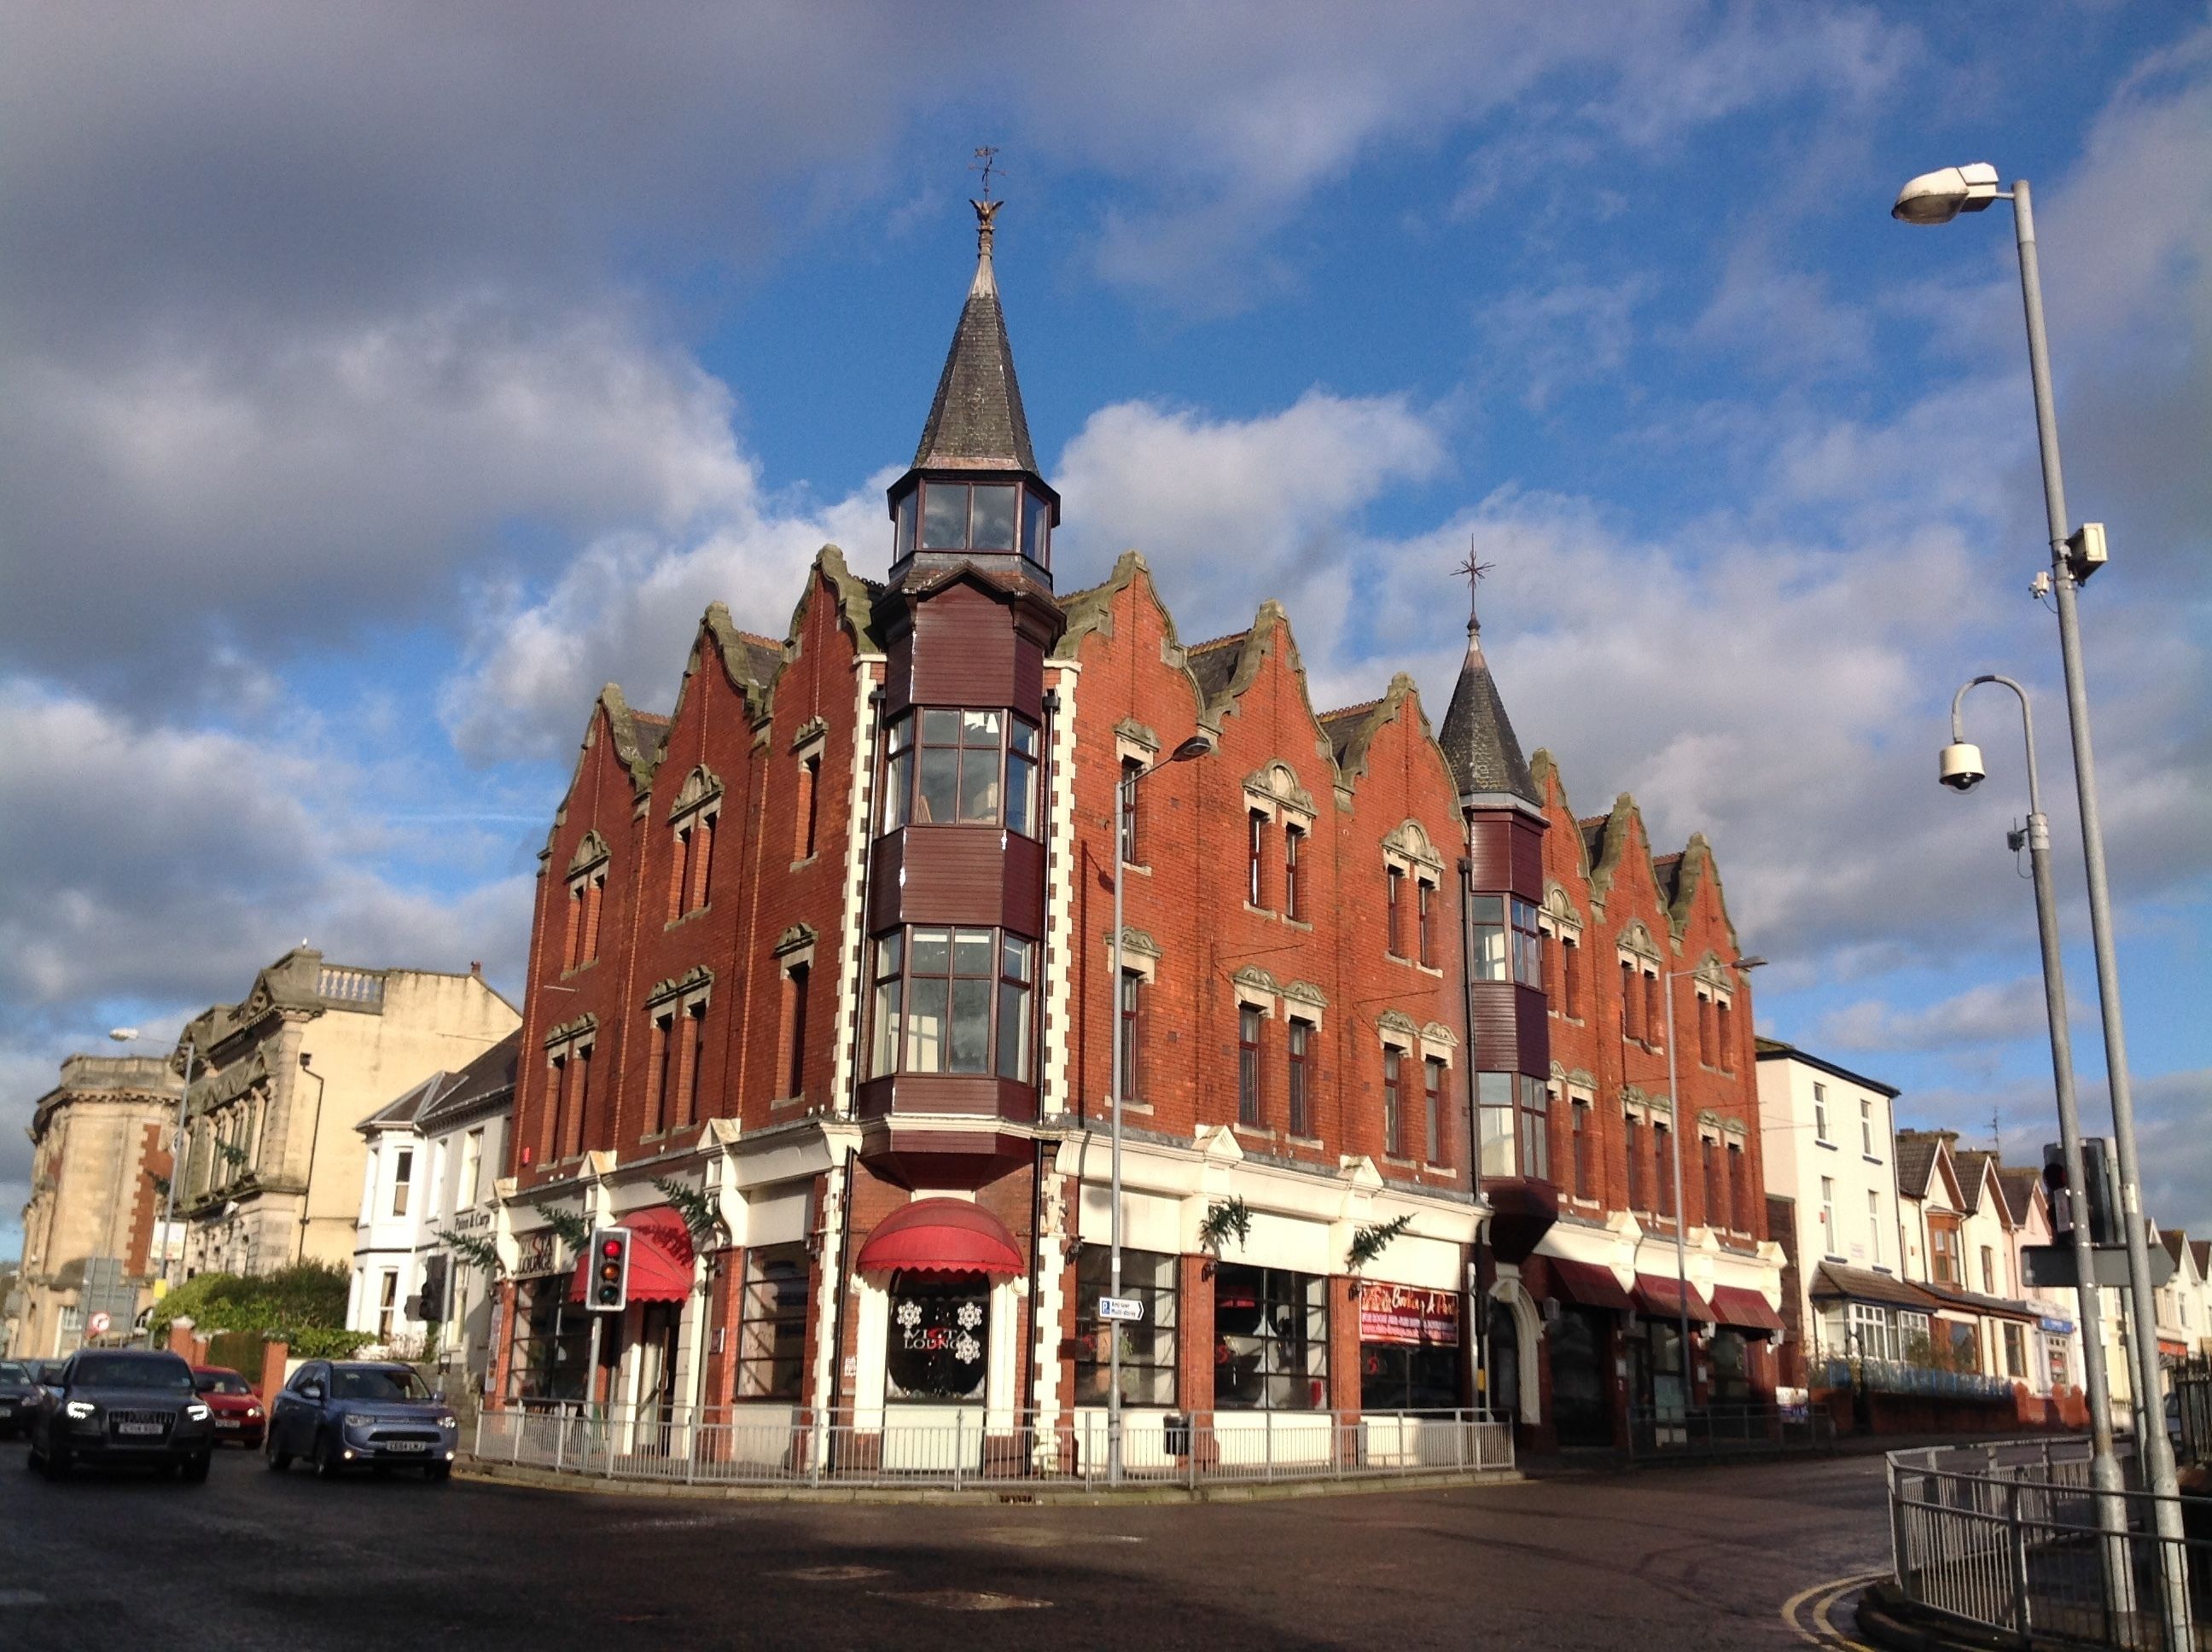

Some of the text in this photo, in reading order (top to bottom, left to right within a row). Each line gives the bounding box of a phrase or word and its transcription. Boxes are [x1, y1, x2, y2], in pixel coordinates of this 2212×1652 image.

[521, 1232, 553, 1254] VISTA
[519, 1252, 553, 1273] LOUNGE
[905, 1327, 969, 1342] VISTA
[905, 1338, 959, 1349] LOUNG
